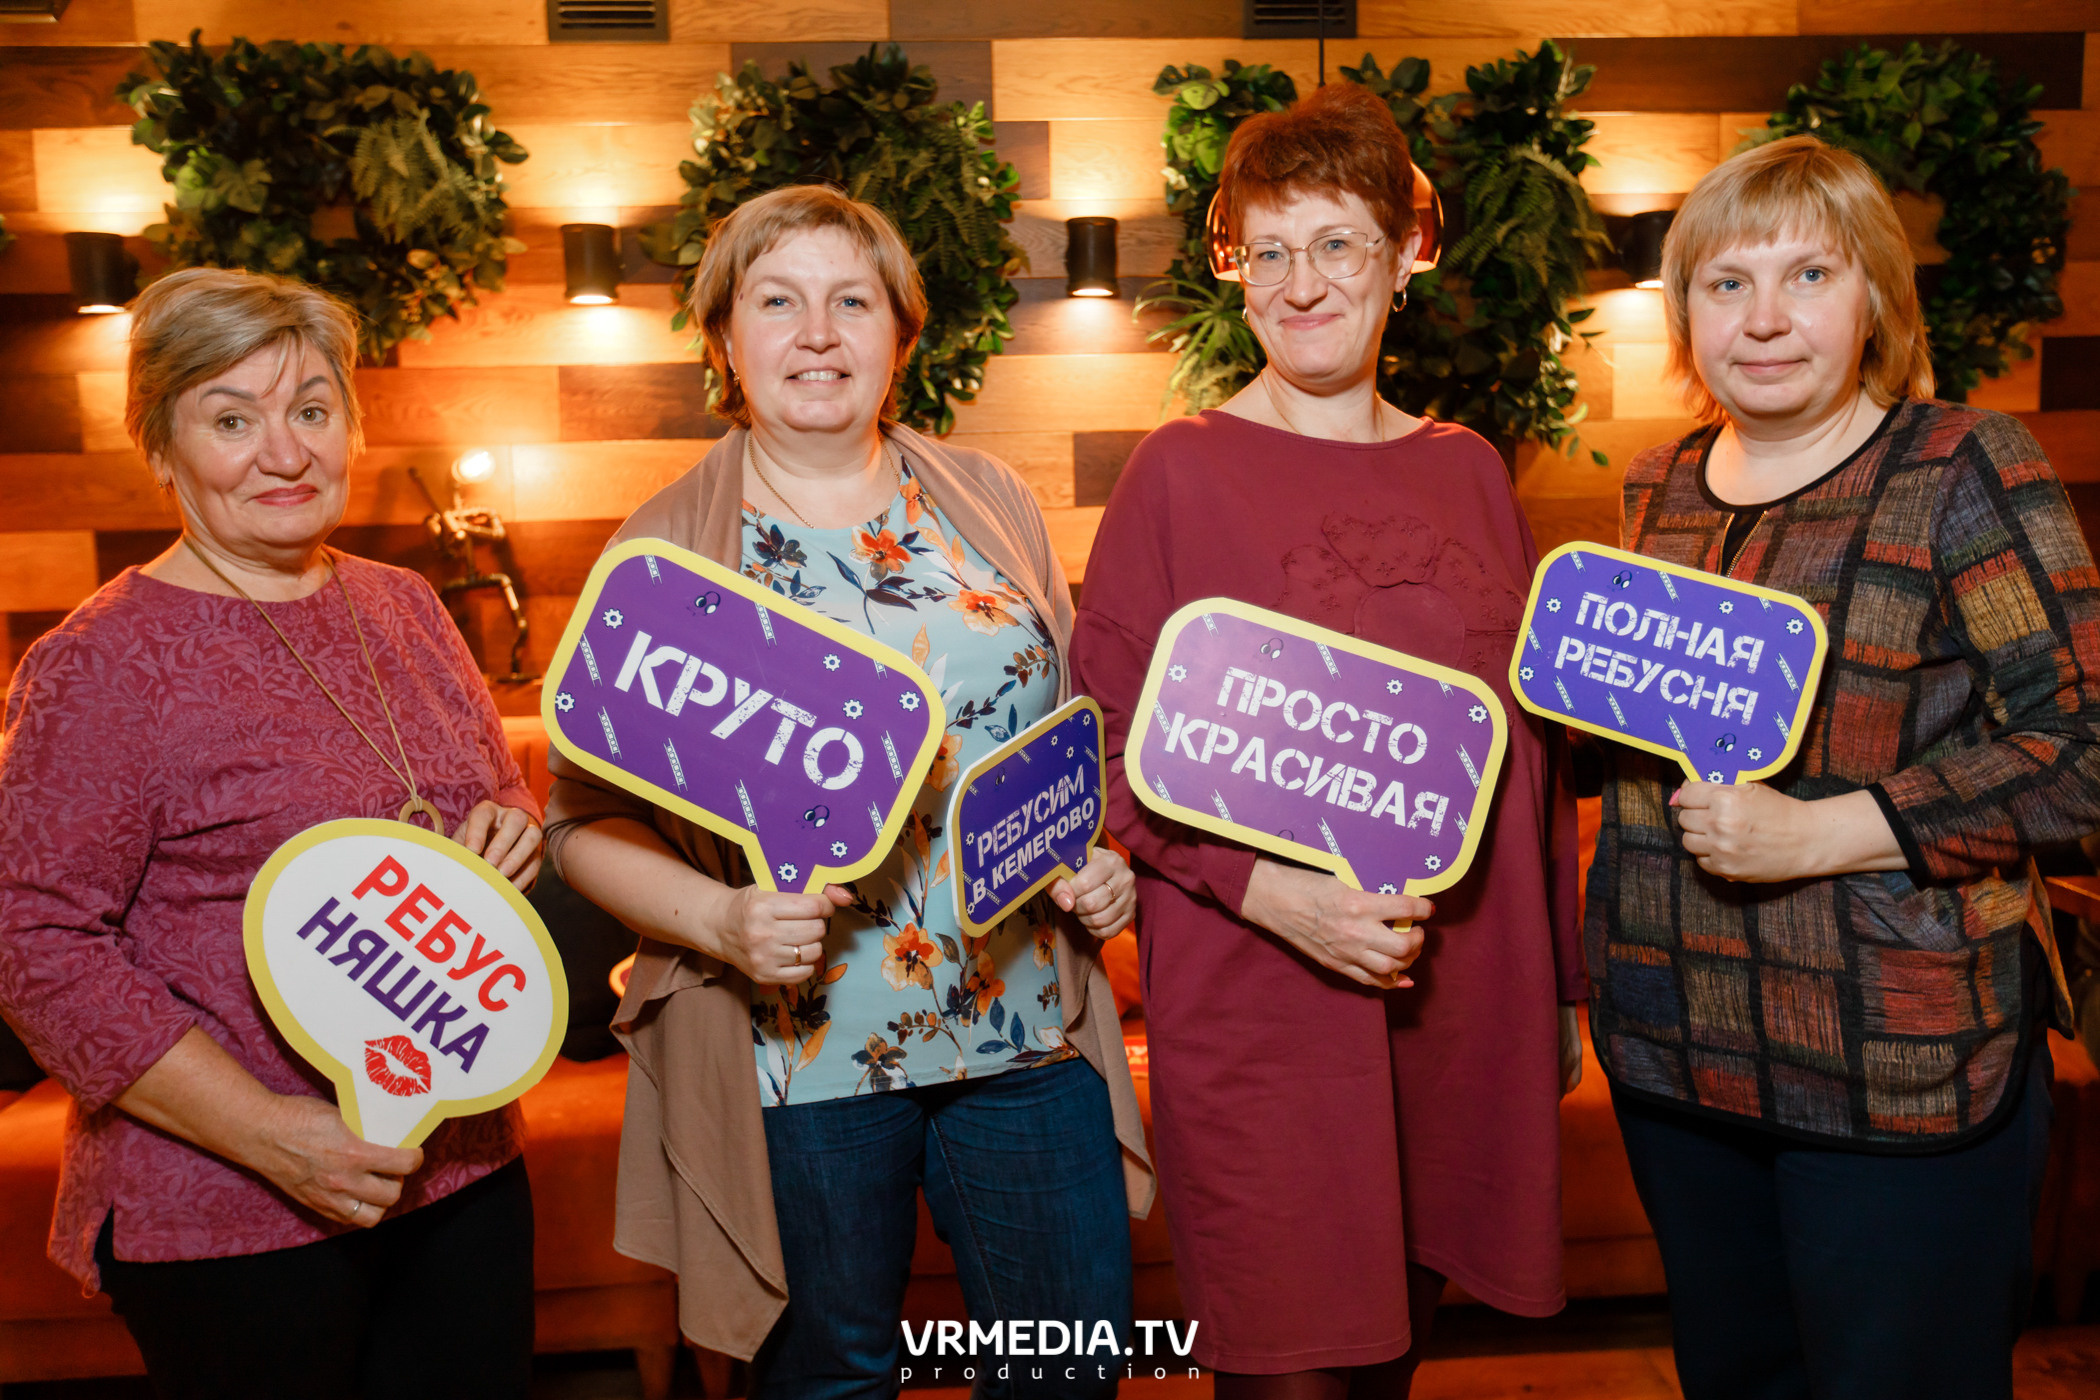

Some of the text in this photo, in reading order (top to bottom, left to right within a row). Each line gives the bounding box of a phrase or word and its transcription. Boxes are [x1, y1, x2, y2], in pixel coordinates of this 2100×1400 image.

[1554, 635, 1759, 726] РЕБУСНЯ
[1575, 591, 1765, 674] ПОЛНАЯ
[614, 630, 864, 790] КРУТО
[1216, 666, 1428, 764] ПРОСТО
[977, 764, 1085, 868] РЕБУСИМ
[1164, 711, 1449, 837] КРАСИВАЯ
[972, 797, 1095, 905] В КЕМЕРОВО
[296, 896, 490, 1074] НЯШКА
[351, 854, 527, 1012] РЕБУС
